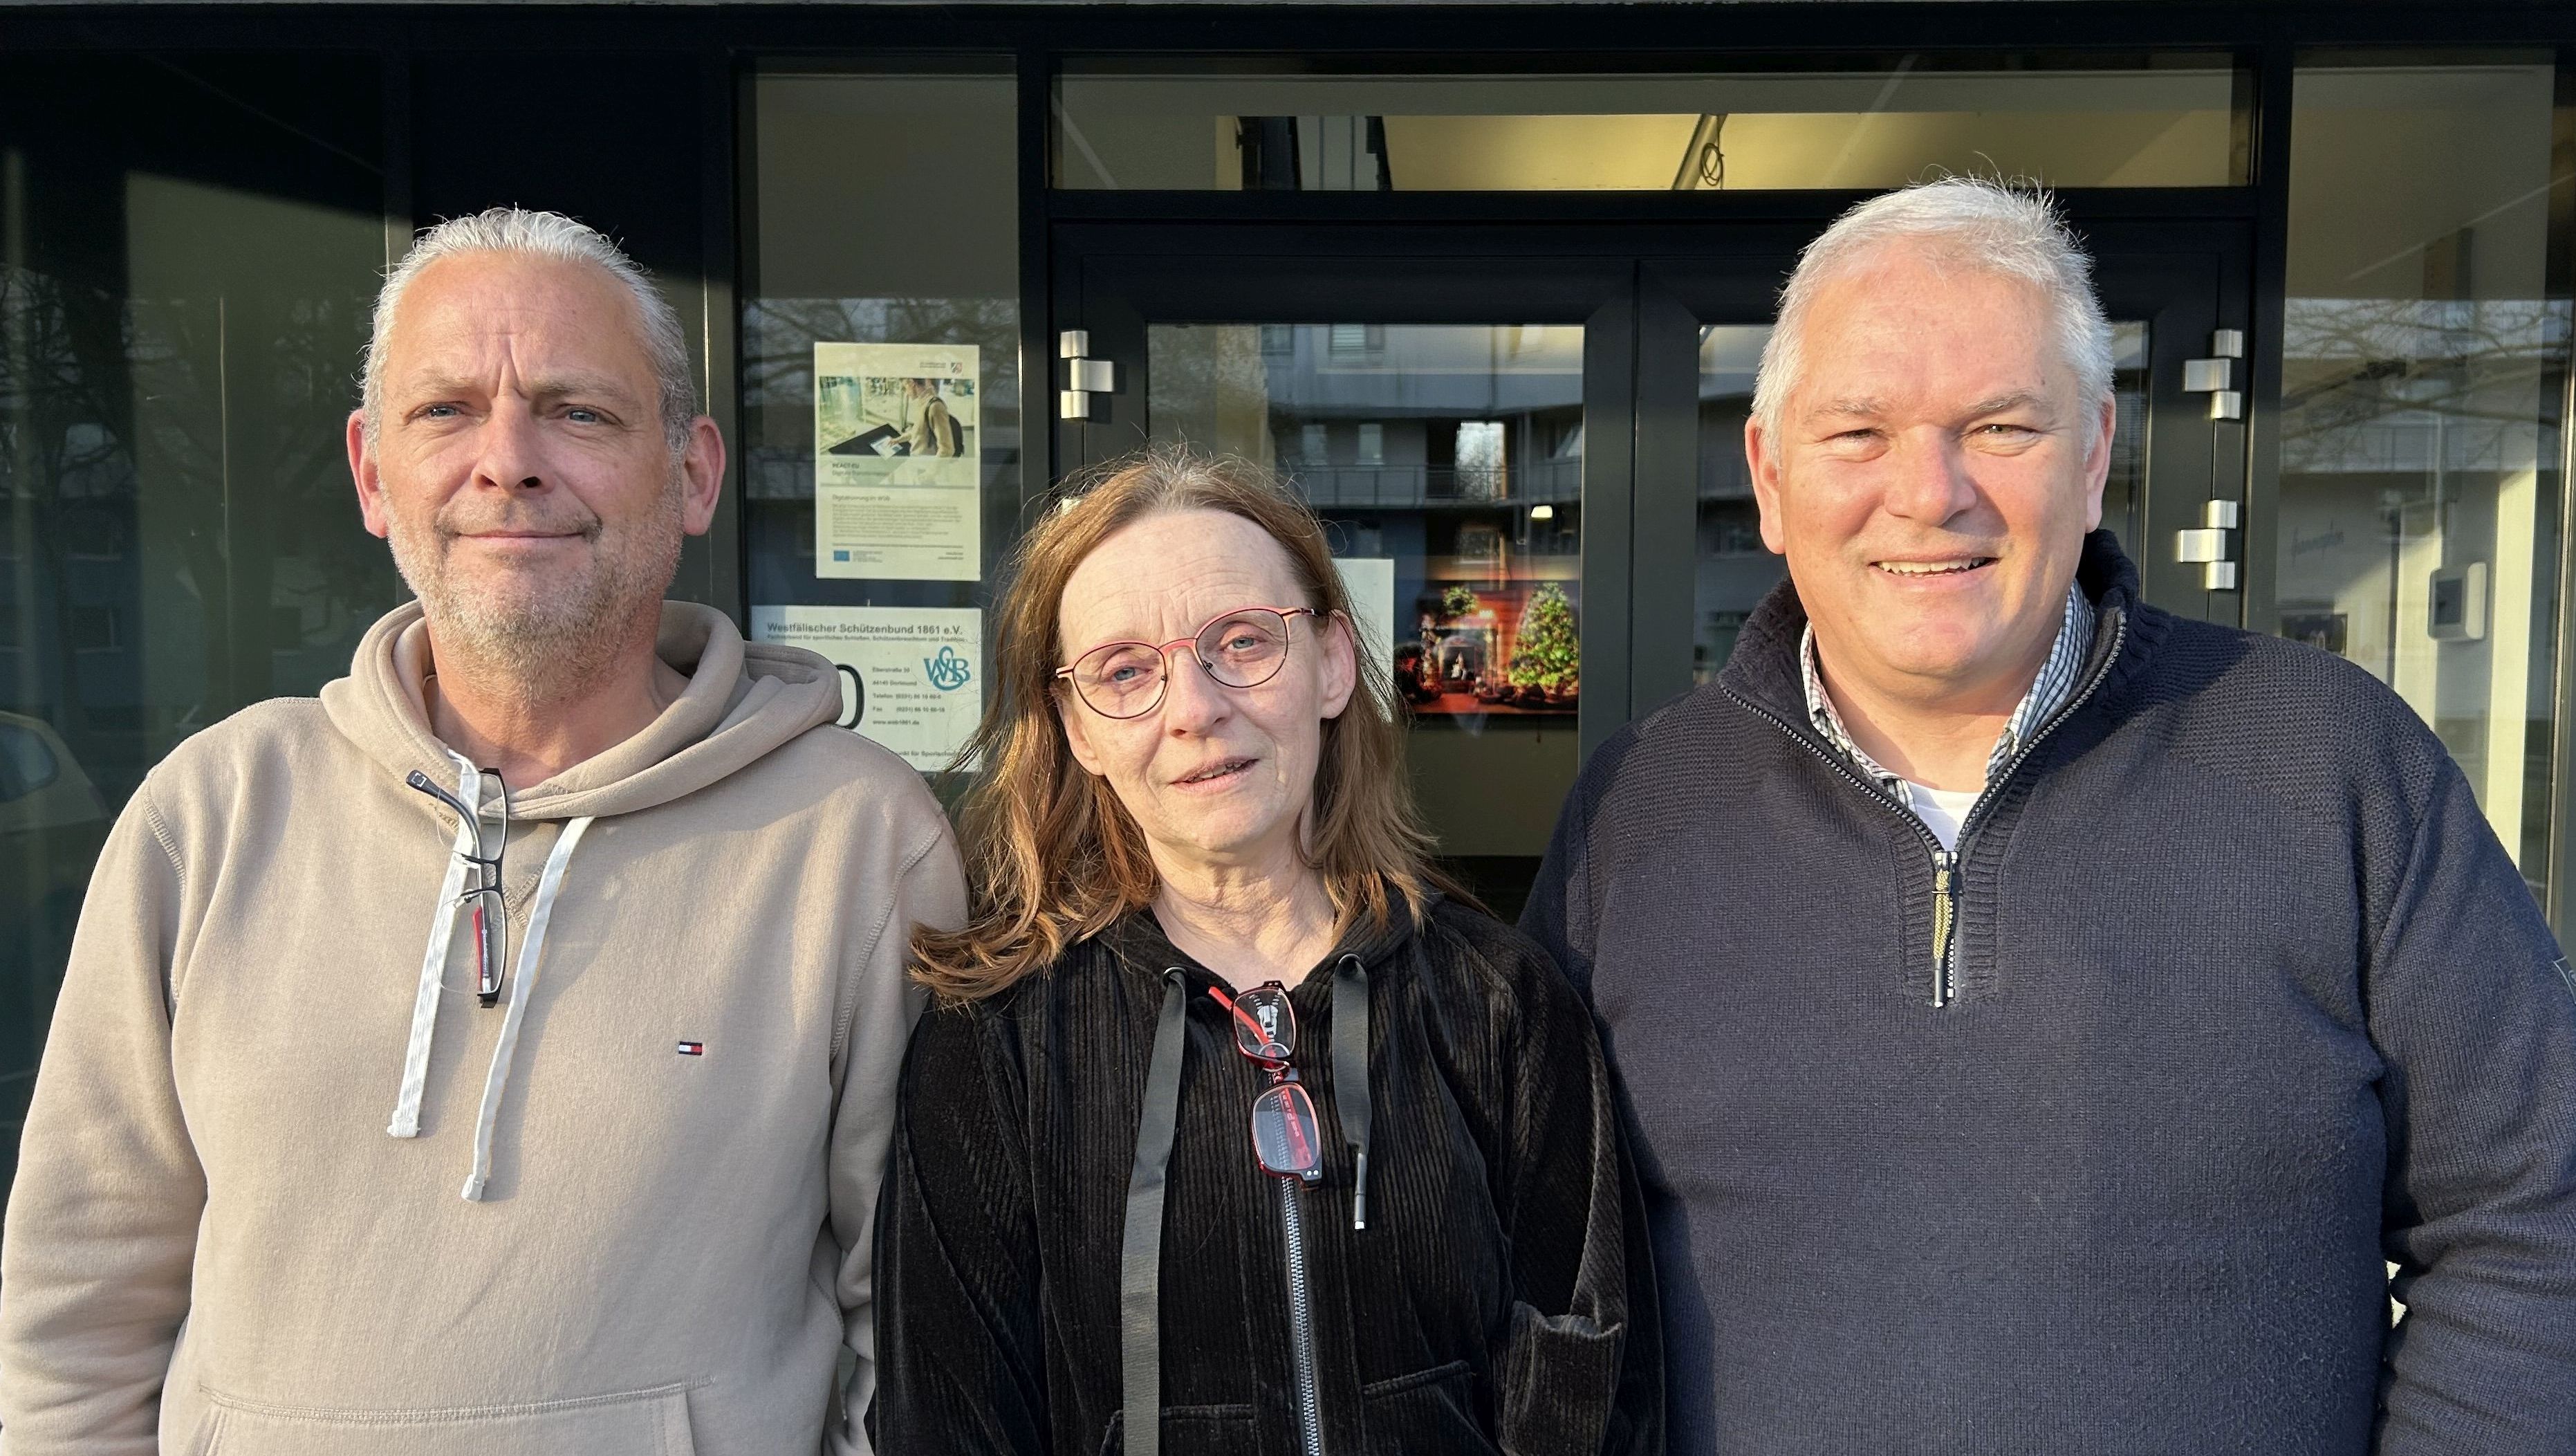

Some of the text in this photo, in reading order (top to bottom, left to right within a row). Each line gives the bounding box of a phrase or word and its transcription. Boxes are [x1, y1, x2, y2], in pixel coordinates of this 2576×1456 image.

[768, 622, 963, 635] Westfälischer Schützenbund 1861 e.V.
